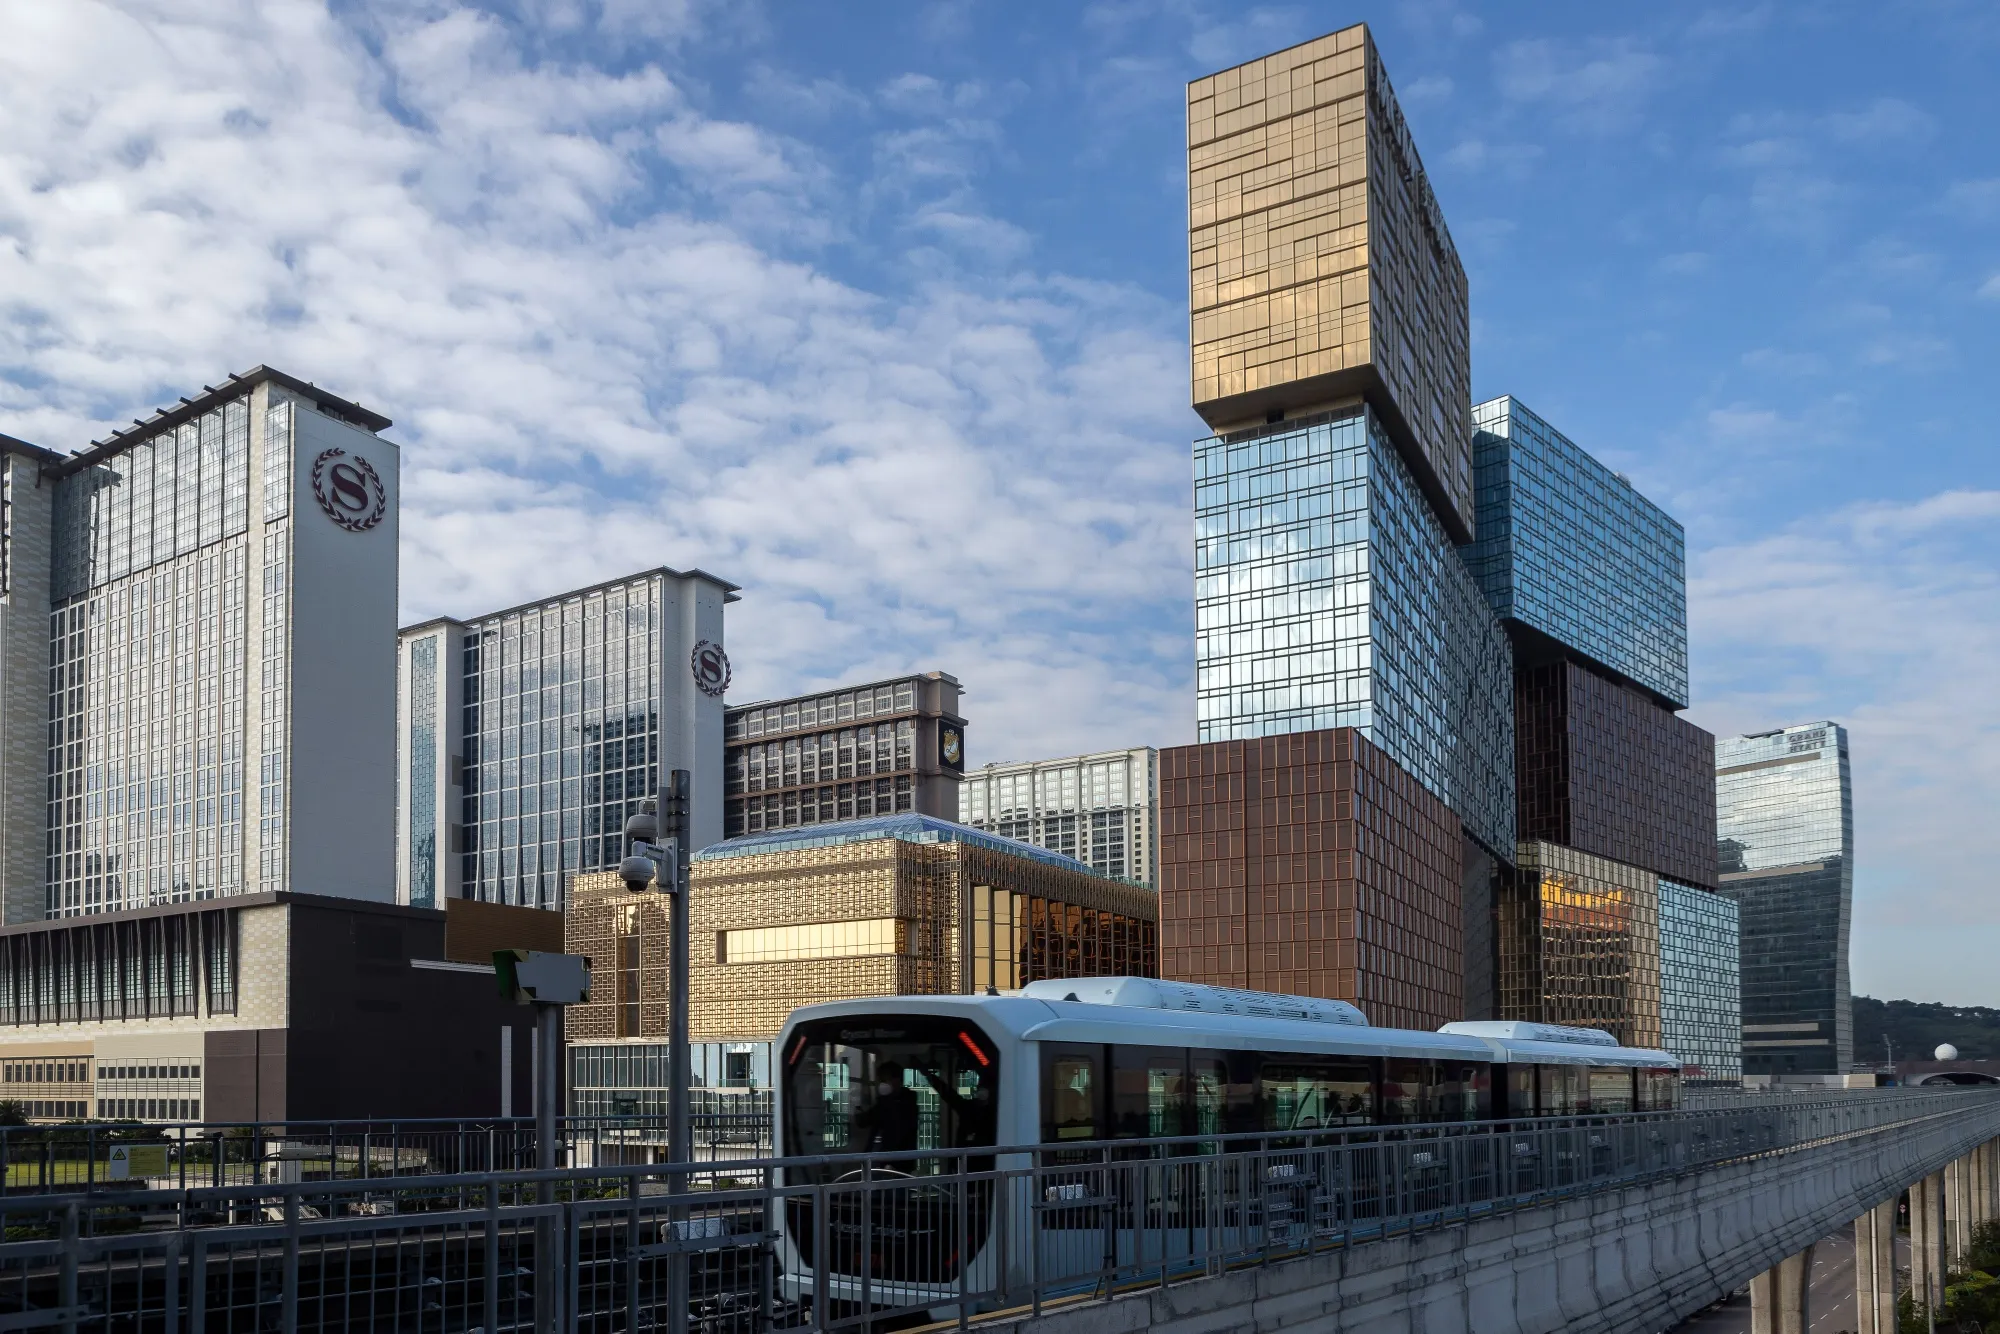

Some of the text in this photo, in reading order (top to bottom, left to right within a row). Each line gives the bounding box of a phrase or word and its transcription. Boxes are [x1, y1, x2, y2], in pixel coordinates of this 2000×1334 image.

[330, 463, 369, 512] S
[700, 650, 721, 683] S
[1789, 729, 1826, 743] GRAND
[1790, 740, 1826, 753] HYATT
